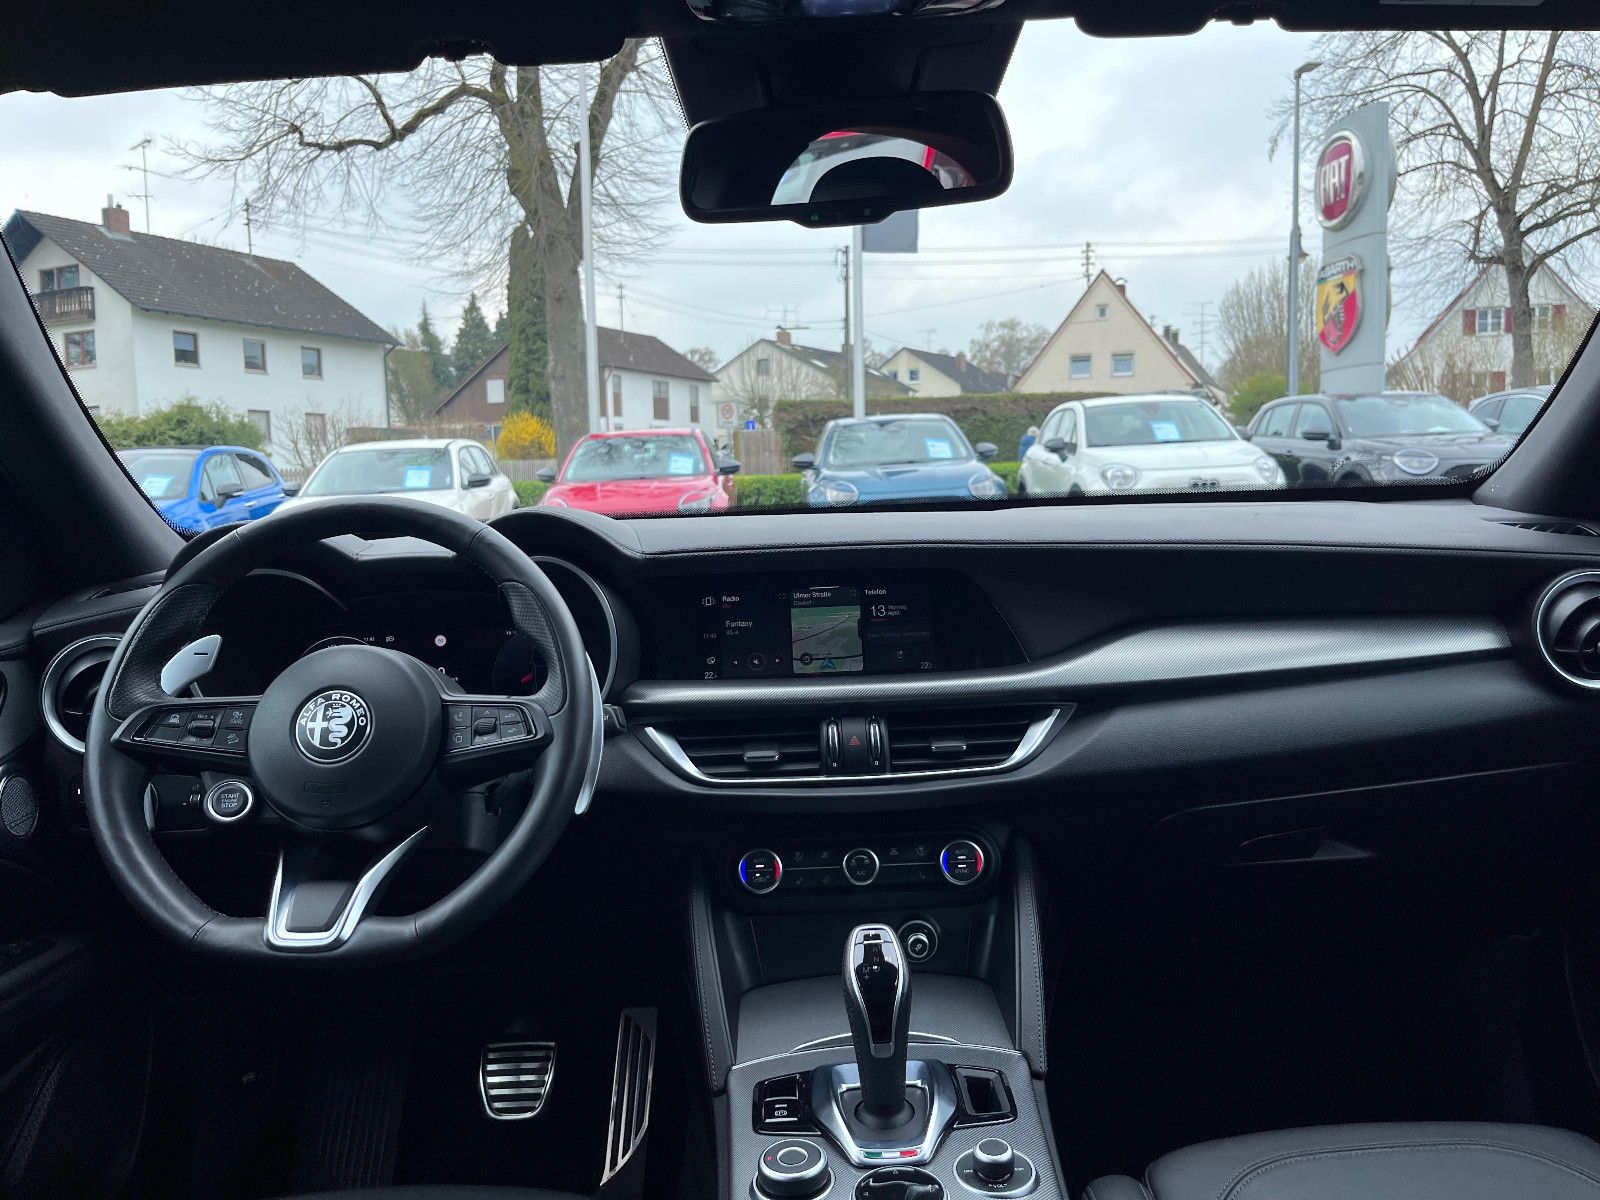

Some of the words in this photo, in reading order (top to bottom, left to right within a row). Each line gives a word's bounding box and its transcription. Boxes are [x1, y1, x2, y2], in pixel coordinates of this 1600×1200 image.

[1320, 154, 1349, 208] FIAT
[864, 588, 887, 596] Telefon
[870, 604, 886, 617] 13
[725, 620, 753, 628] Fantasy
[299, 697, 326, 726] ALFA
[331, 693, 367, 726] ROMEO
[220, 792, 241, 800] START
